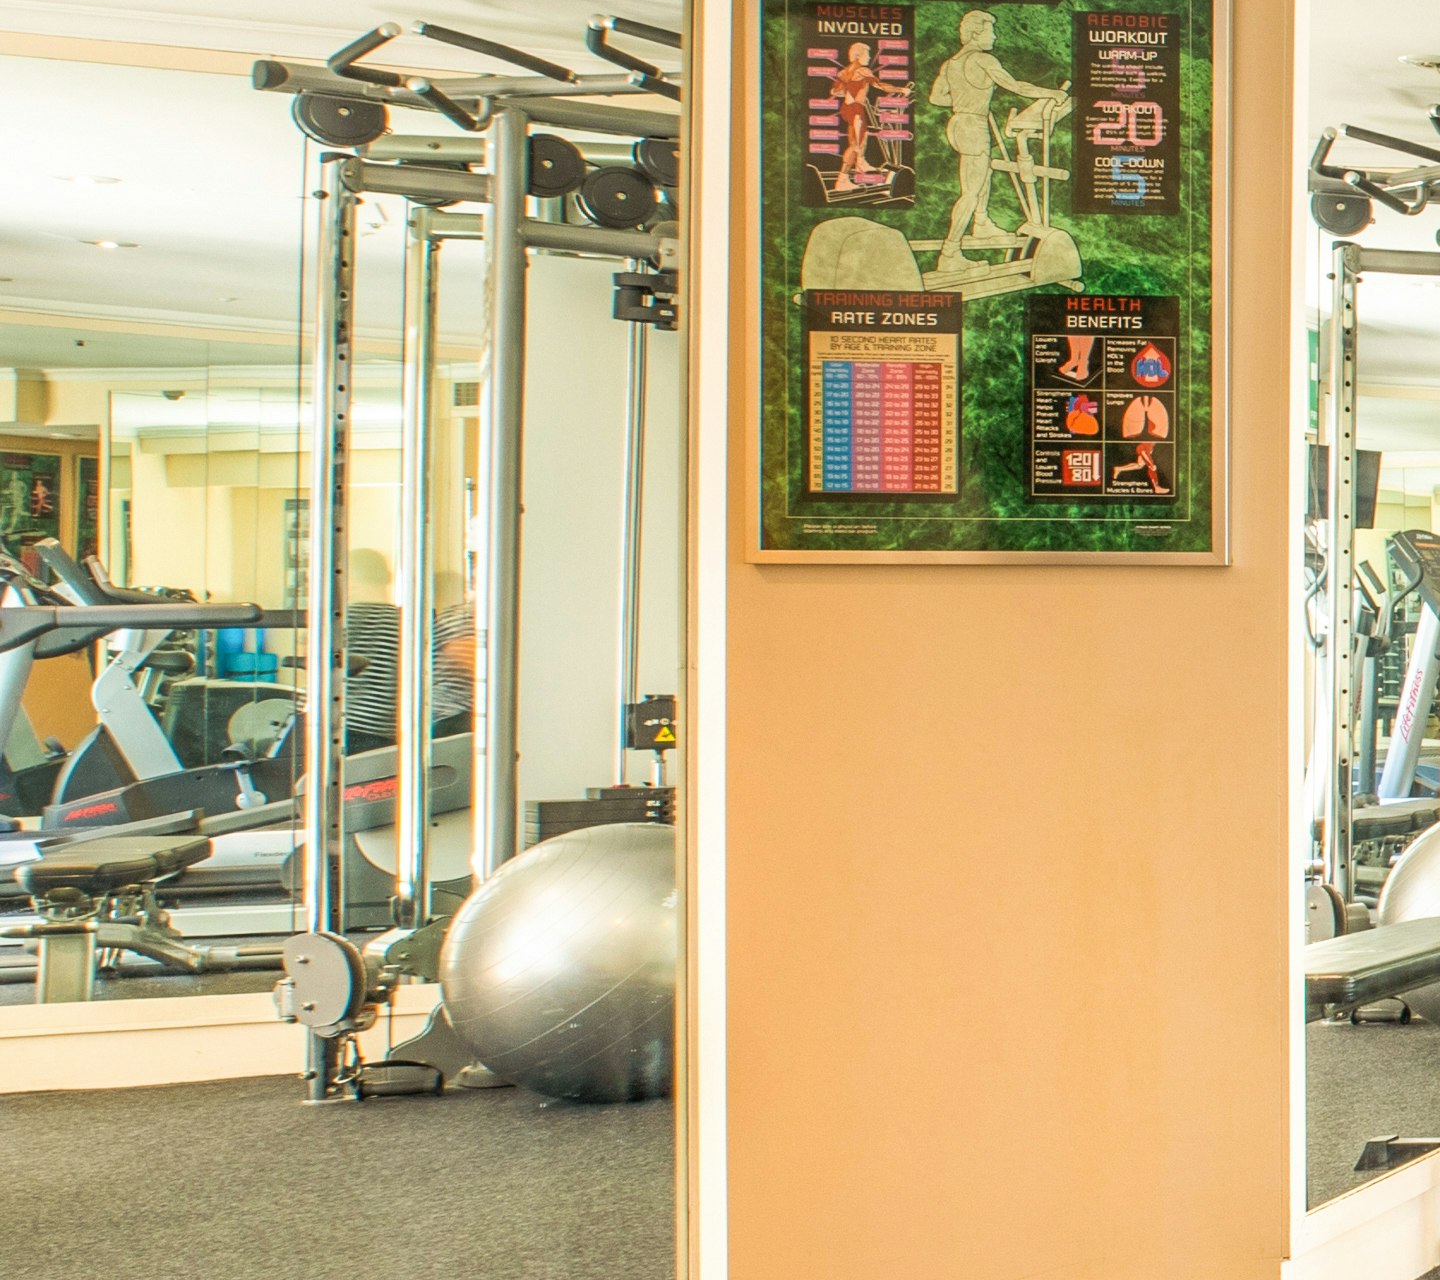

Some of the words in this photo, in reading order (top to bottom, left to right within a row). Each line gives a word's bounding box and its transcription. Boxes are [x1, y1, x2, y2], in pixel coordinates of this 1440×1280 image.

[817, 4, 902, 20] MUSCLES
[818, 20, 902, 36] INVOLVED
[1087, 14, 1168, 28] AEROBIC
[1089, 30, 1168, 44] WORKOUT
[1098, 49, 1158, 61] WARM-UP
[1095, 157, 1164, 168] COOL-DOWN
[814, 292, 893, 306] TRAINING
[899, 294, 954, 308] HEART
[1067, 297, 1142, 311] HEALTH
[831, 311, 875, 324] RATE
[881, 313, 938, 326] ZONES
[1067, 315, 1143, 329] BENEFITS
[879, 336, 906, 344] HEART
[1066, 453, 1092, 466] 120
[1072, 468, 1092, 482] 80
